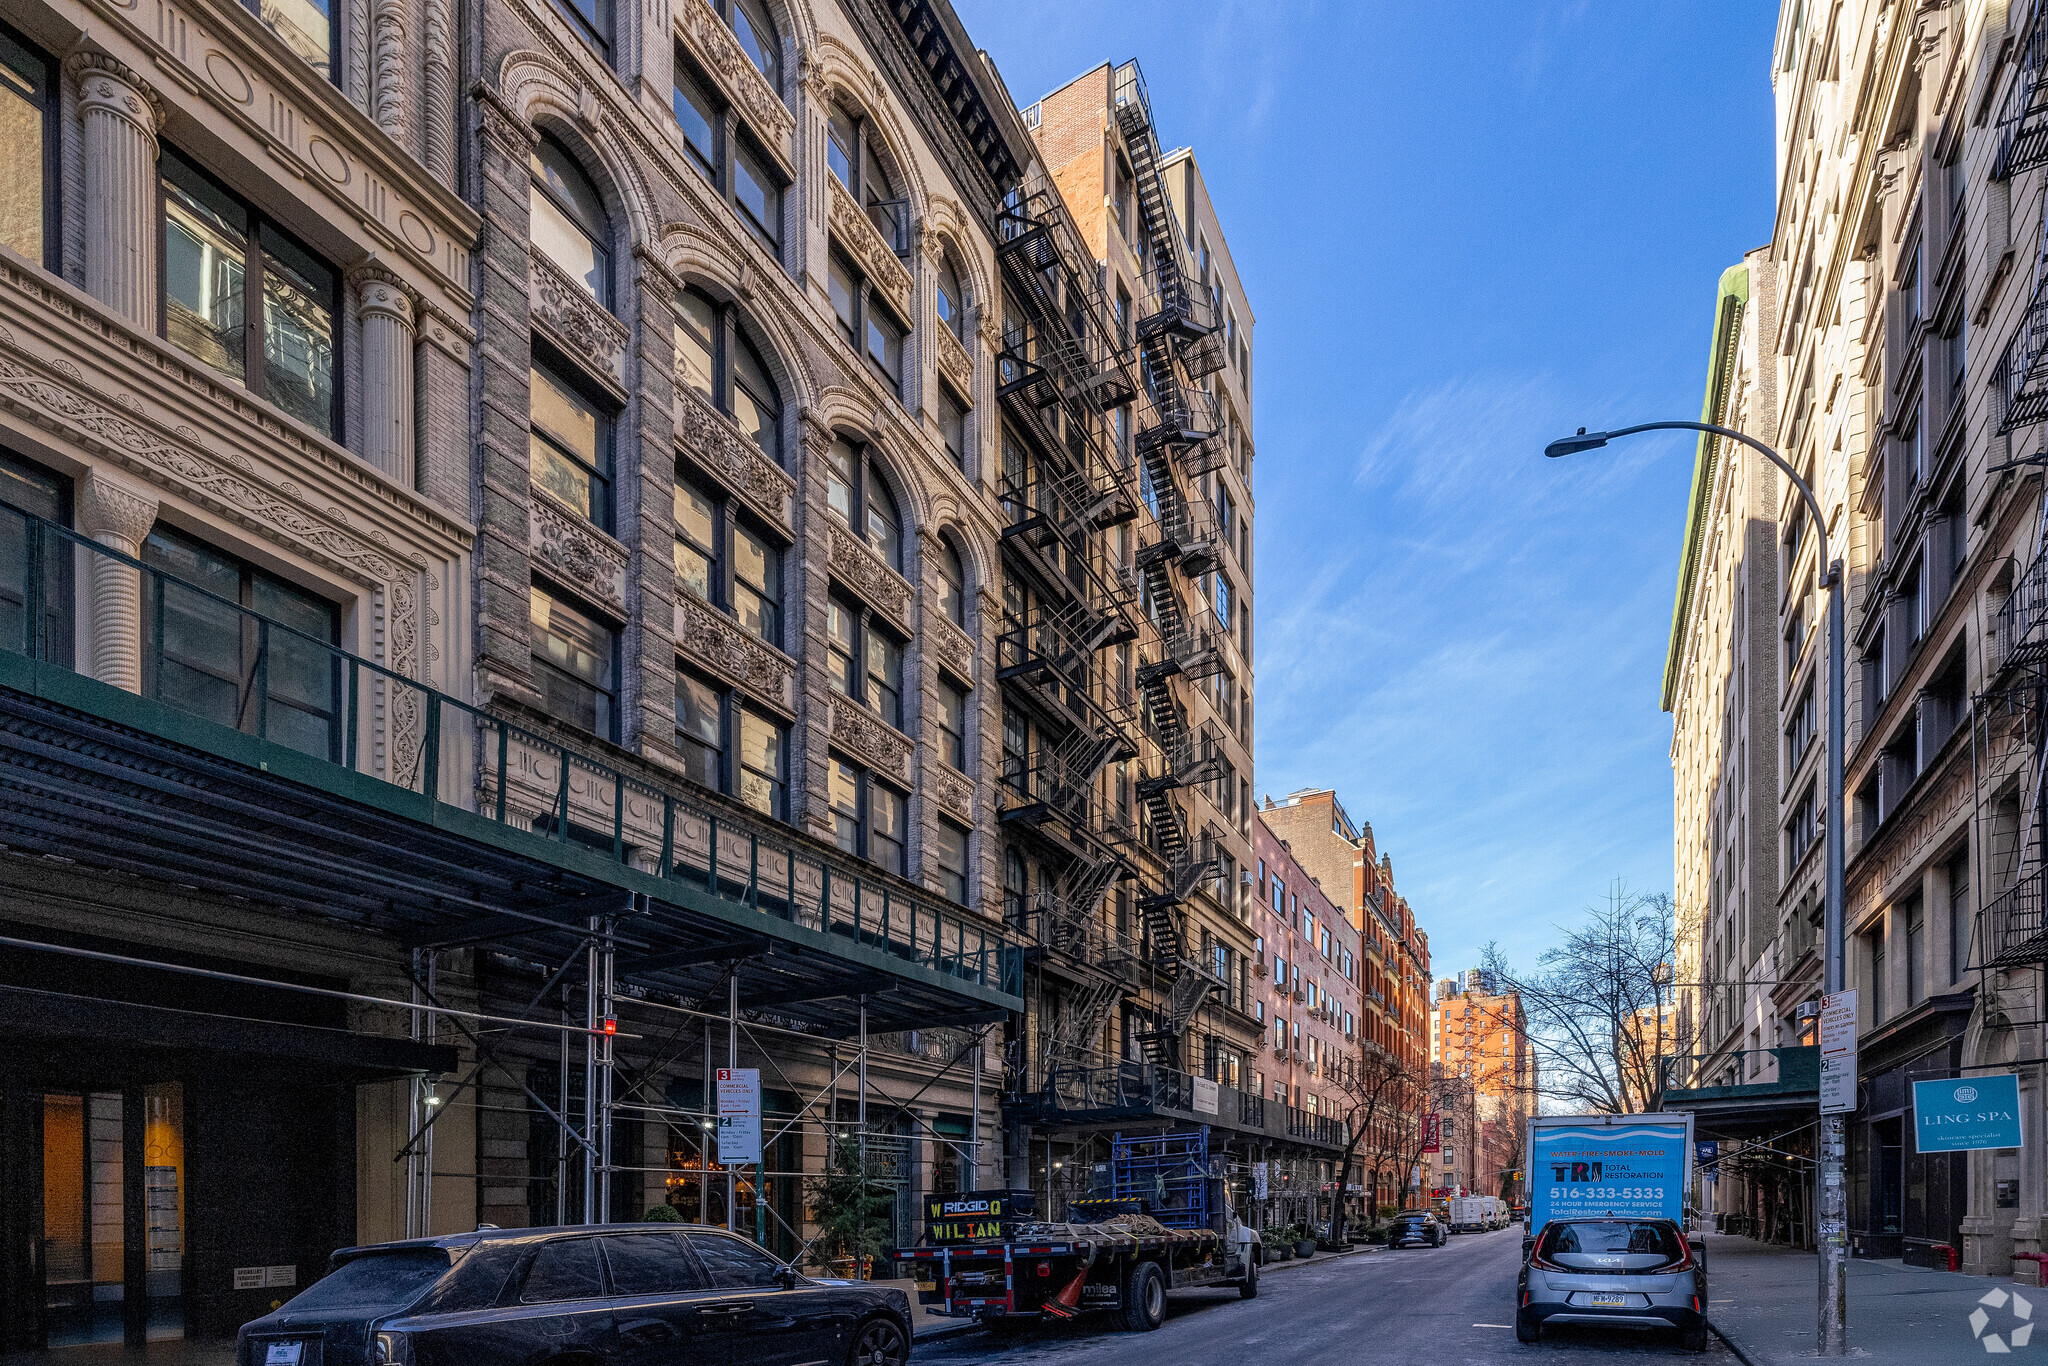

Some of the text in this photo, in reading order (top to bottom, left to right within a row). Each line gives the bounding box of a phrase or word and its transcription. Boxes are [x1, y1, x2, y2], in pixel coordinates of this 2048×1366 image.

[1823, 997, 1829, 1009] 3
[1823, 1006, 1851, 1018] COMMERCIAL
[1823, 1014, 1842, 1024] VEHICLES
[1822, 1060, 1828, 1071] 2
[721, 1070, 728, 1080] 3
[721, 1117, 729, 1127] 2
[1925, 1111, 2012, 1126] LING SPA
[1968, 1132, 2001, 1140] specialist
[1551, 1162, 1602, 1182] TRI
[1550, 1187, 1664, 1199] 516-333-5333
[931, 1203, 941, 1218] W
[944, 1201, 989, 1213] RIDGID
[933, 1222, 1000, 1239] WILIAN
[1082, 1282, 1117, 1294] milea
